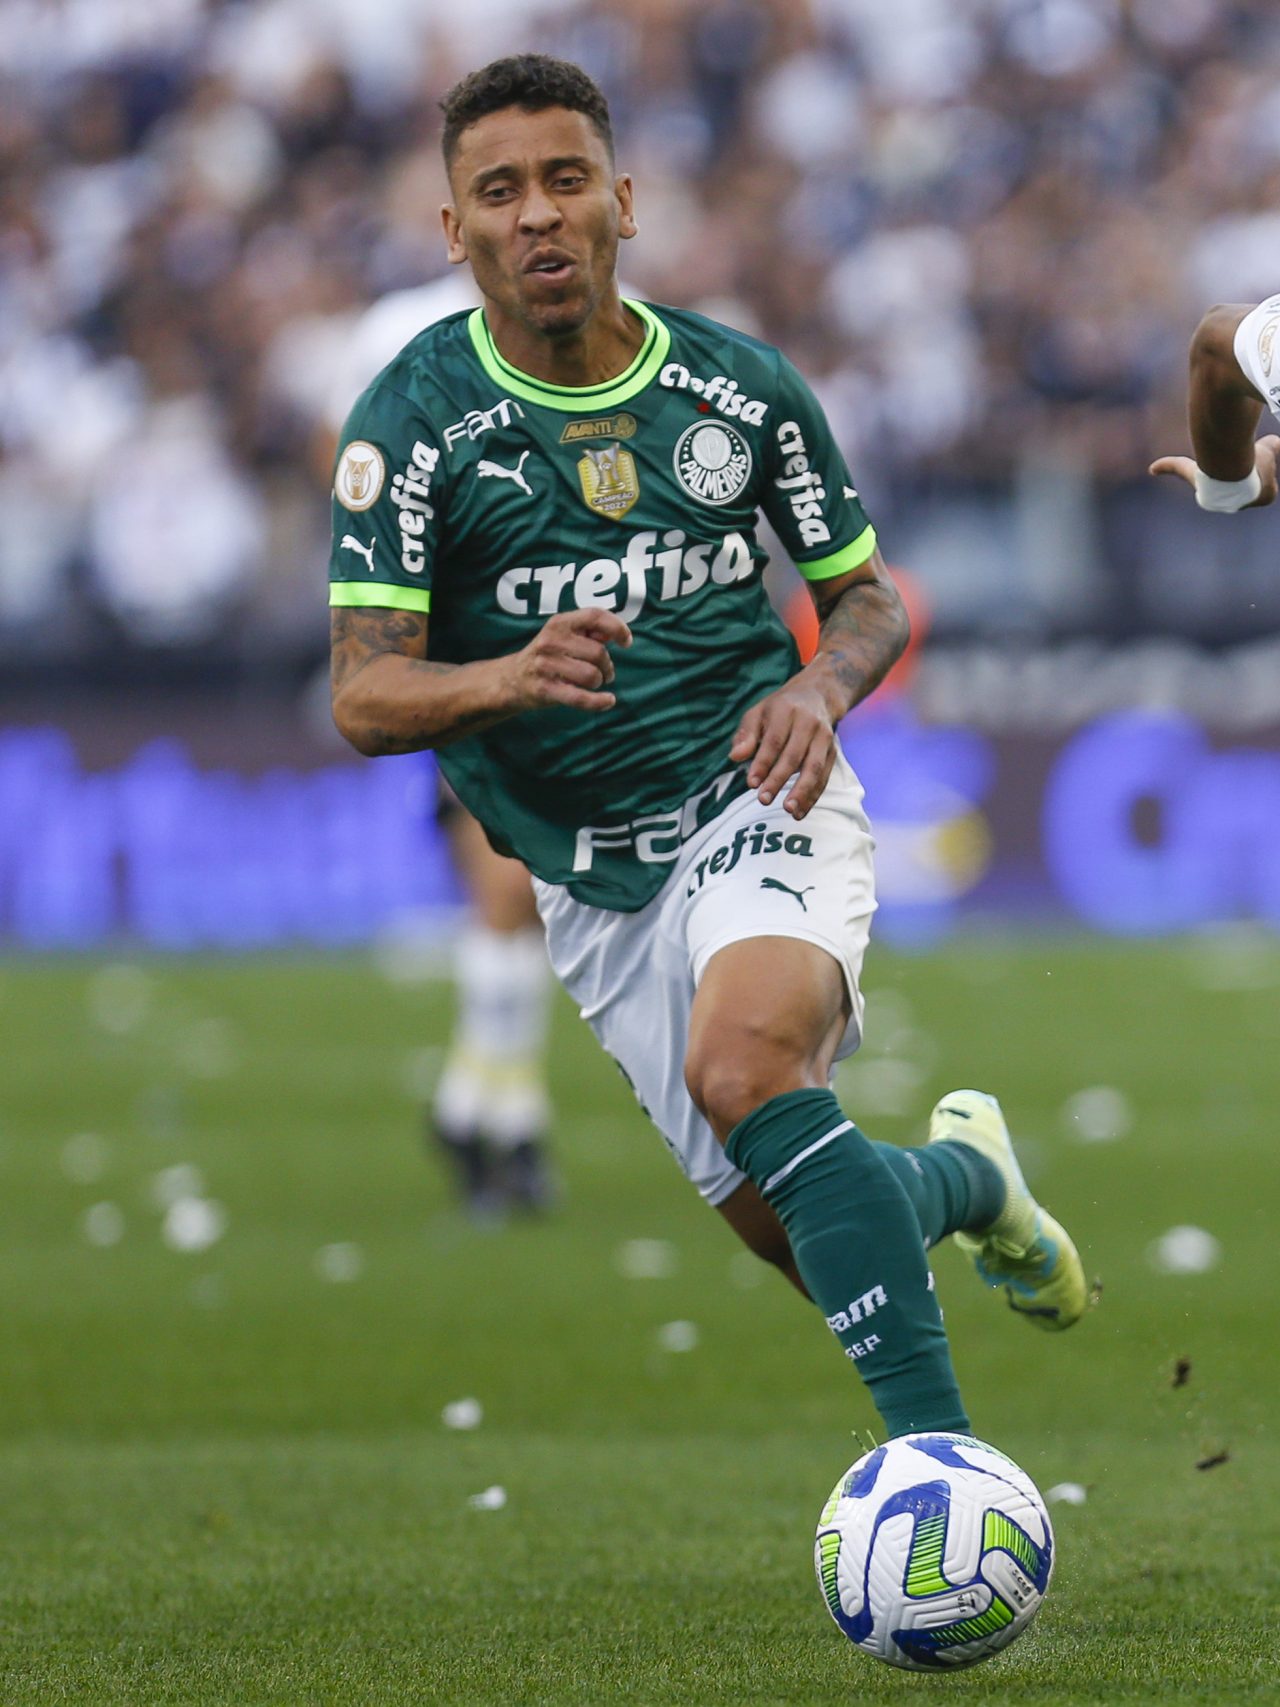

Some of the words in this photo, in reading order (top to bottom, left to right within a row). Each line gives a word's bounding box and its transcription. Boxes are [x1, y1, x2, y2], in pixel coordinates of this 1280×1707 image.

[565, 421, 612, 439] AVANTI
[680, 453, 748, 500] PALMEIRAS
[390, 440, 440, 574] crefisa
[775, 421, 831, 547] crefisa
[496, 529, 755, 625] crefisa
